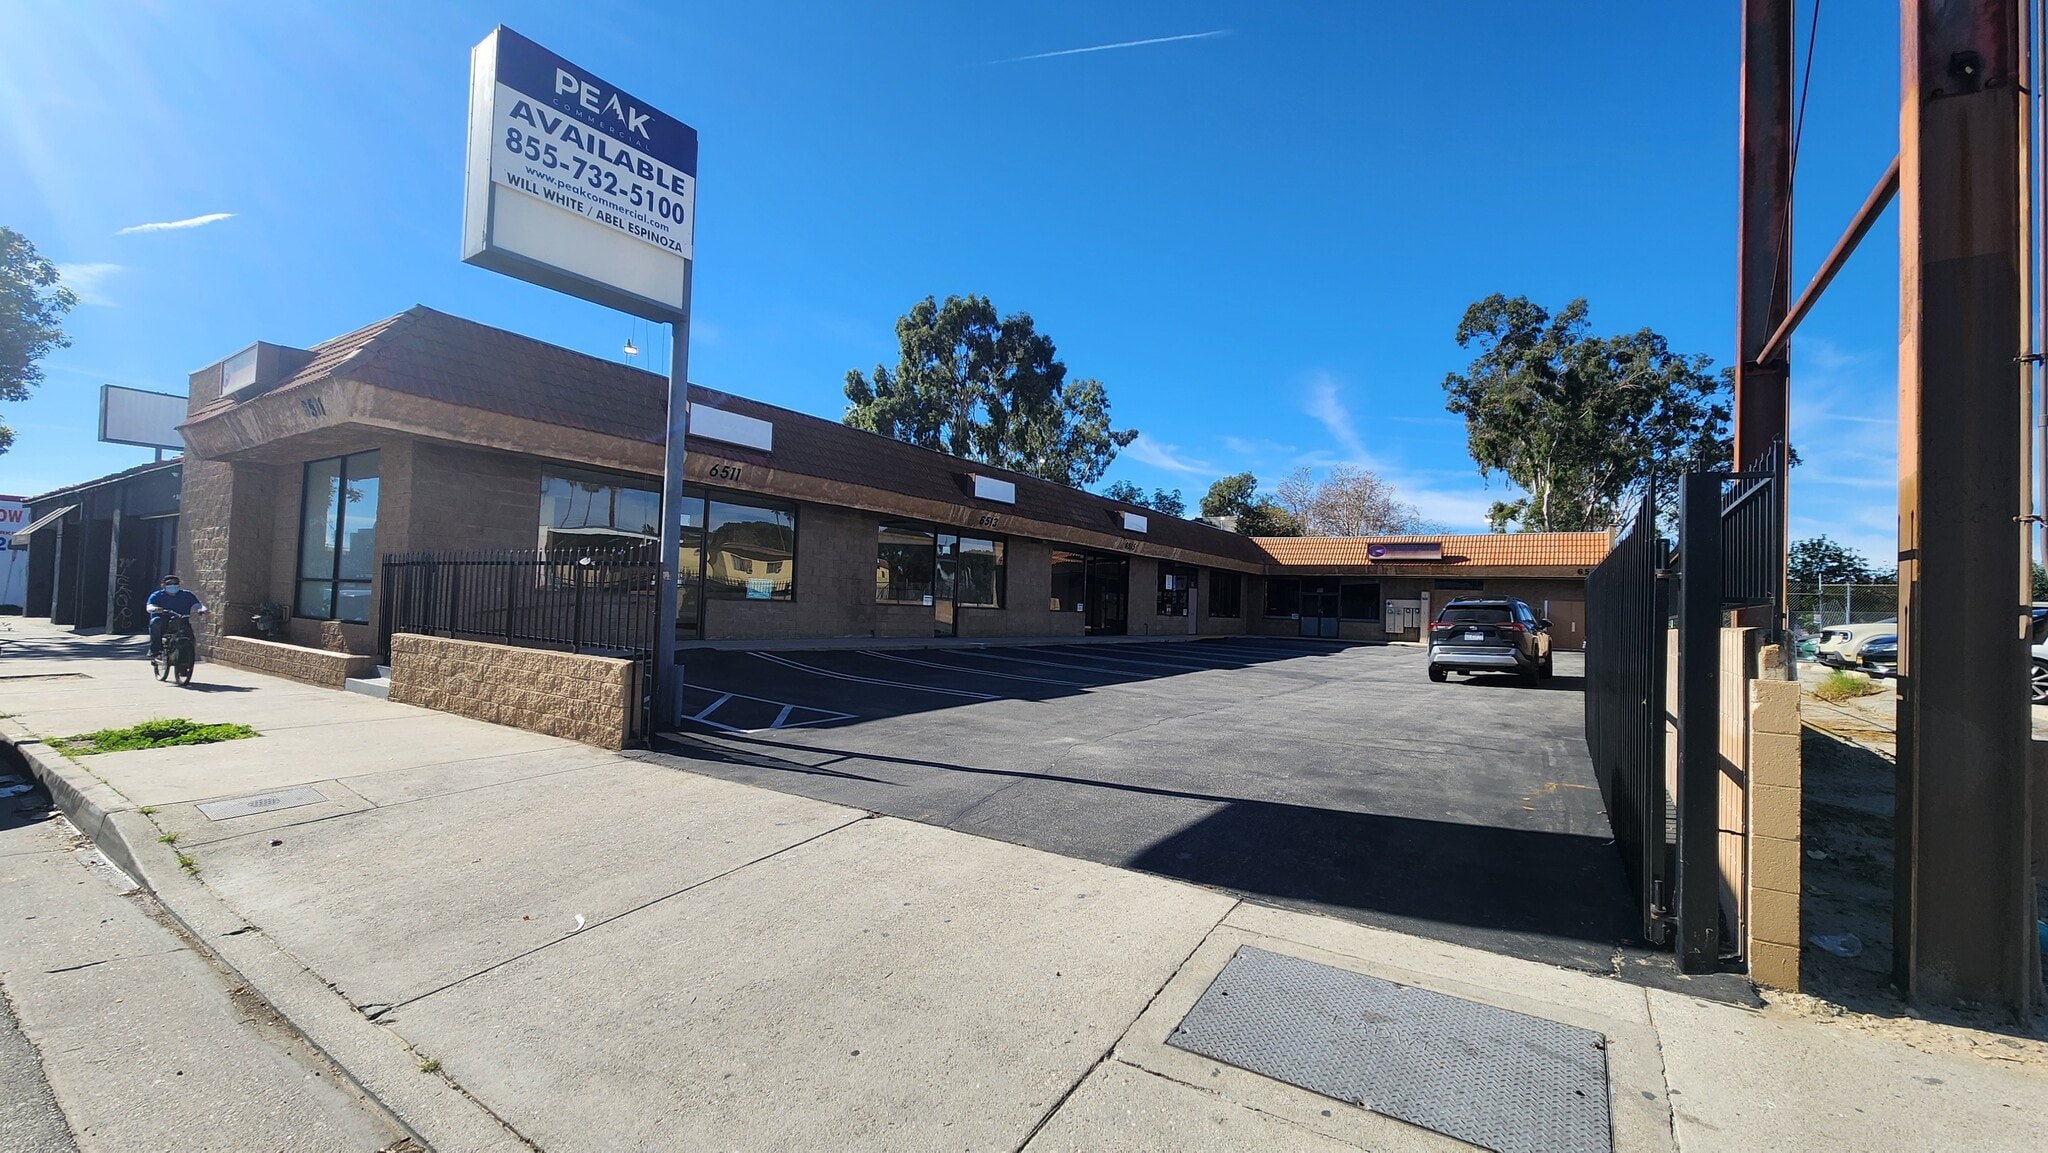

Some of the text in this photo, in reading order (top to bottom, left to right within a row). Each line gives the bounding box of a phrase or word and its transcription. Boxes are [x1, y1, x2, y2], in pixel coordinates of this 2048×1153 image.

[553, 98, 650, 150] COMMERCIAL
[555, 67, 650, 140] PEAK
[505, 127, 685, 224] 855-732-5100
[510, 100, 685, 197] AVAILABLE
[507, 172, 539, 195] WILL
[543, 188, 584, 214] WHITE
[596, 209, 625, 231] ABEL
[628, 223, 683, 253] ESPINOZA
[526, 165, 669, 232] www.peakcommercial.com
[709, 464, 741, 481] 6511
[980, 516, 998, 527] 6513
